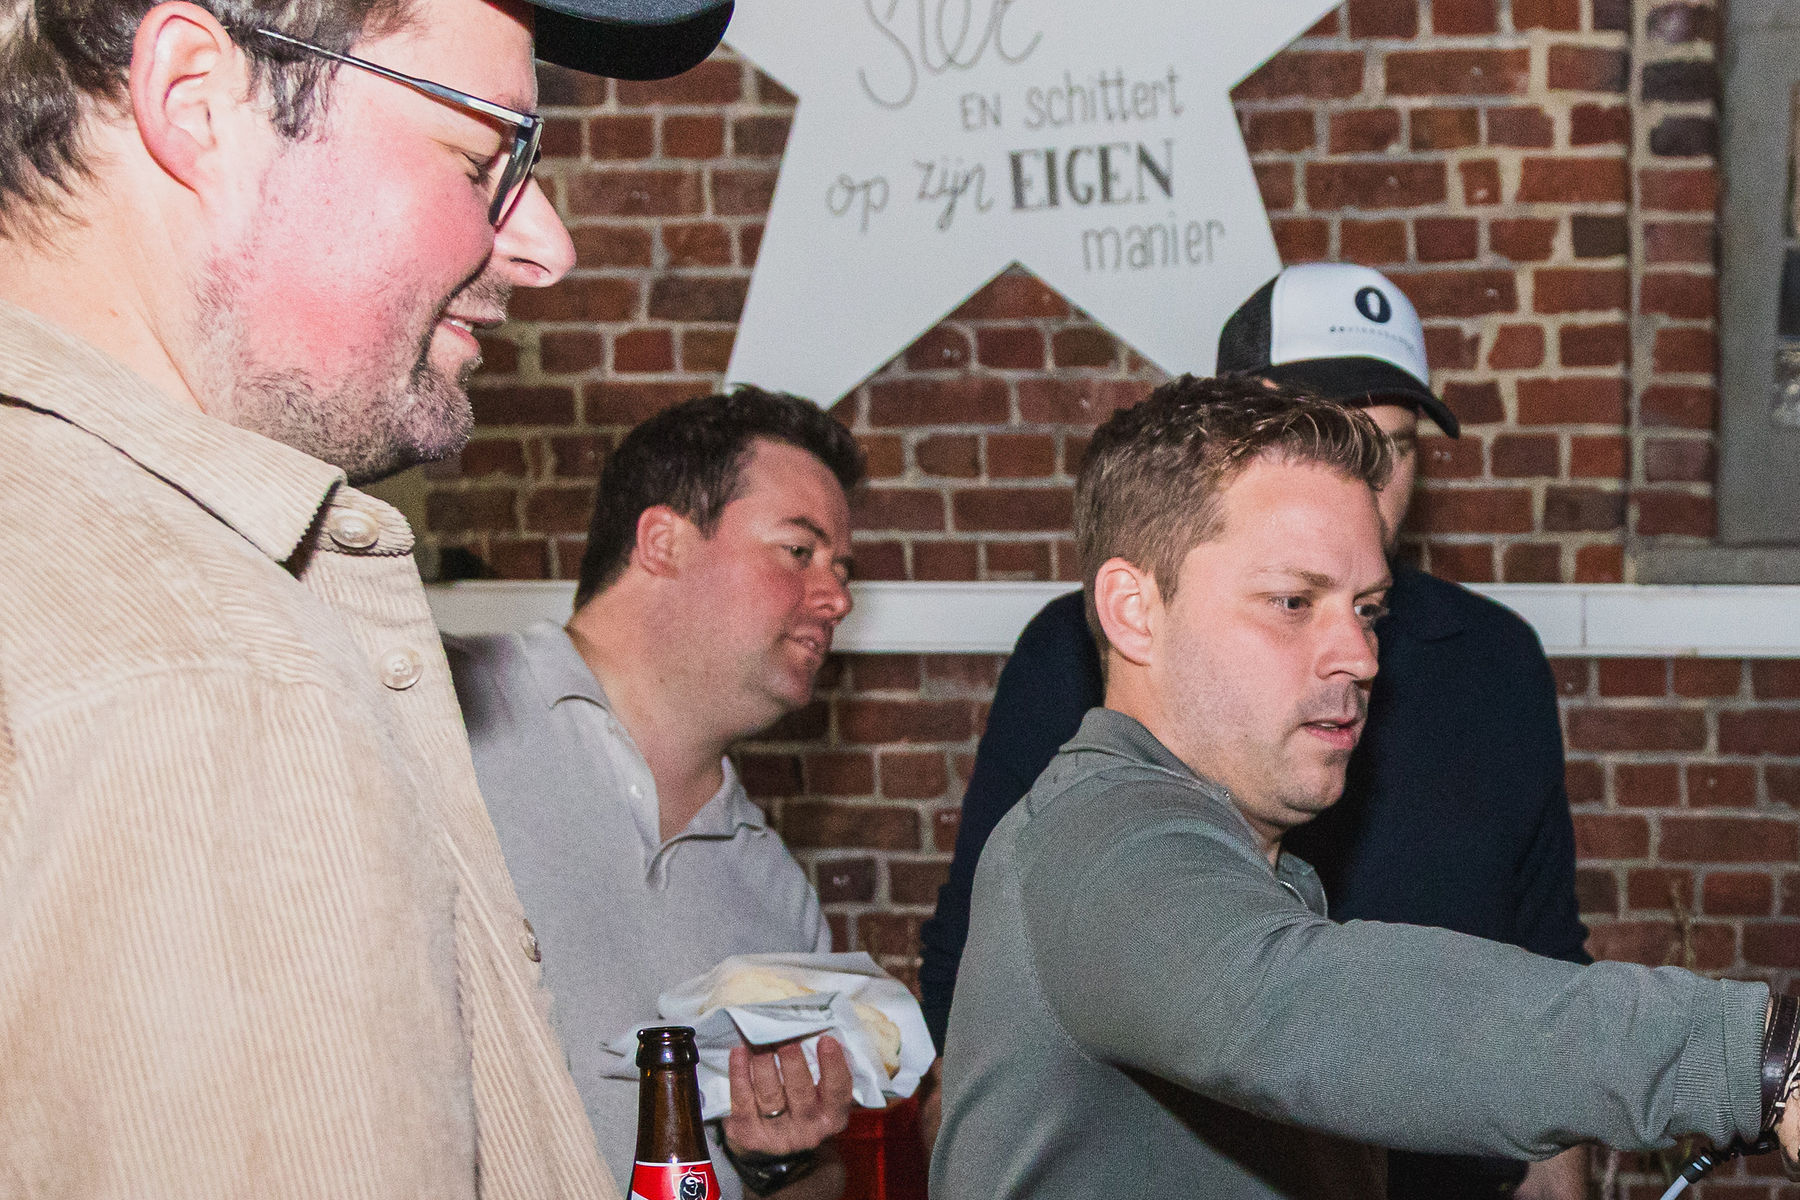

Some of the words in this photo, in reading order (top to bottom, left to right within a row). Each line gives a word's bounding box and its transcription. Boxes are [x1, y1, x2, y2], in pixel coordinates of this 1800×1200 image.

[961, 91, 1001, 131] EN
[1023, 66, 1184, 131] schittert
[826, 171, 890, 234] op
[912, 158, 995, 233] zijn
[1008, 140, 1176, 211] EIGEN
[1082, 217, 1225, 272] manier
